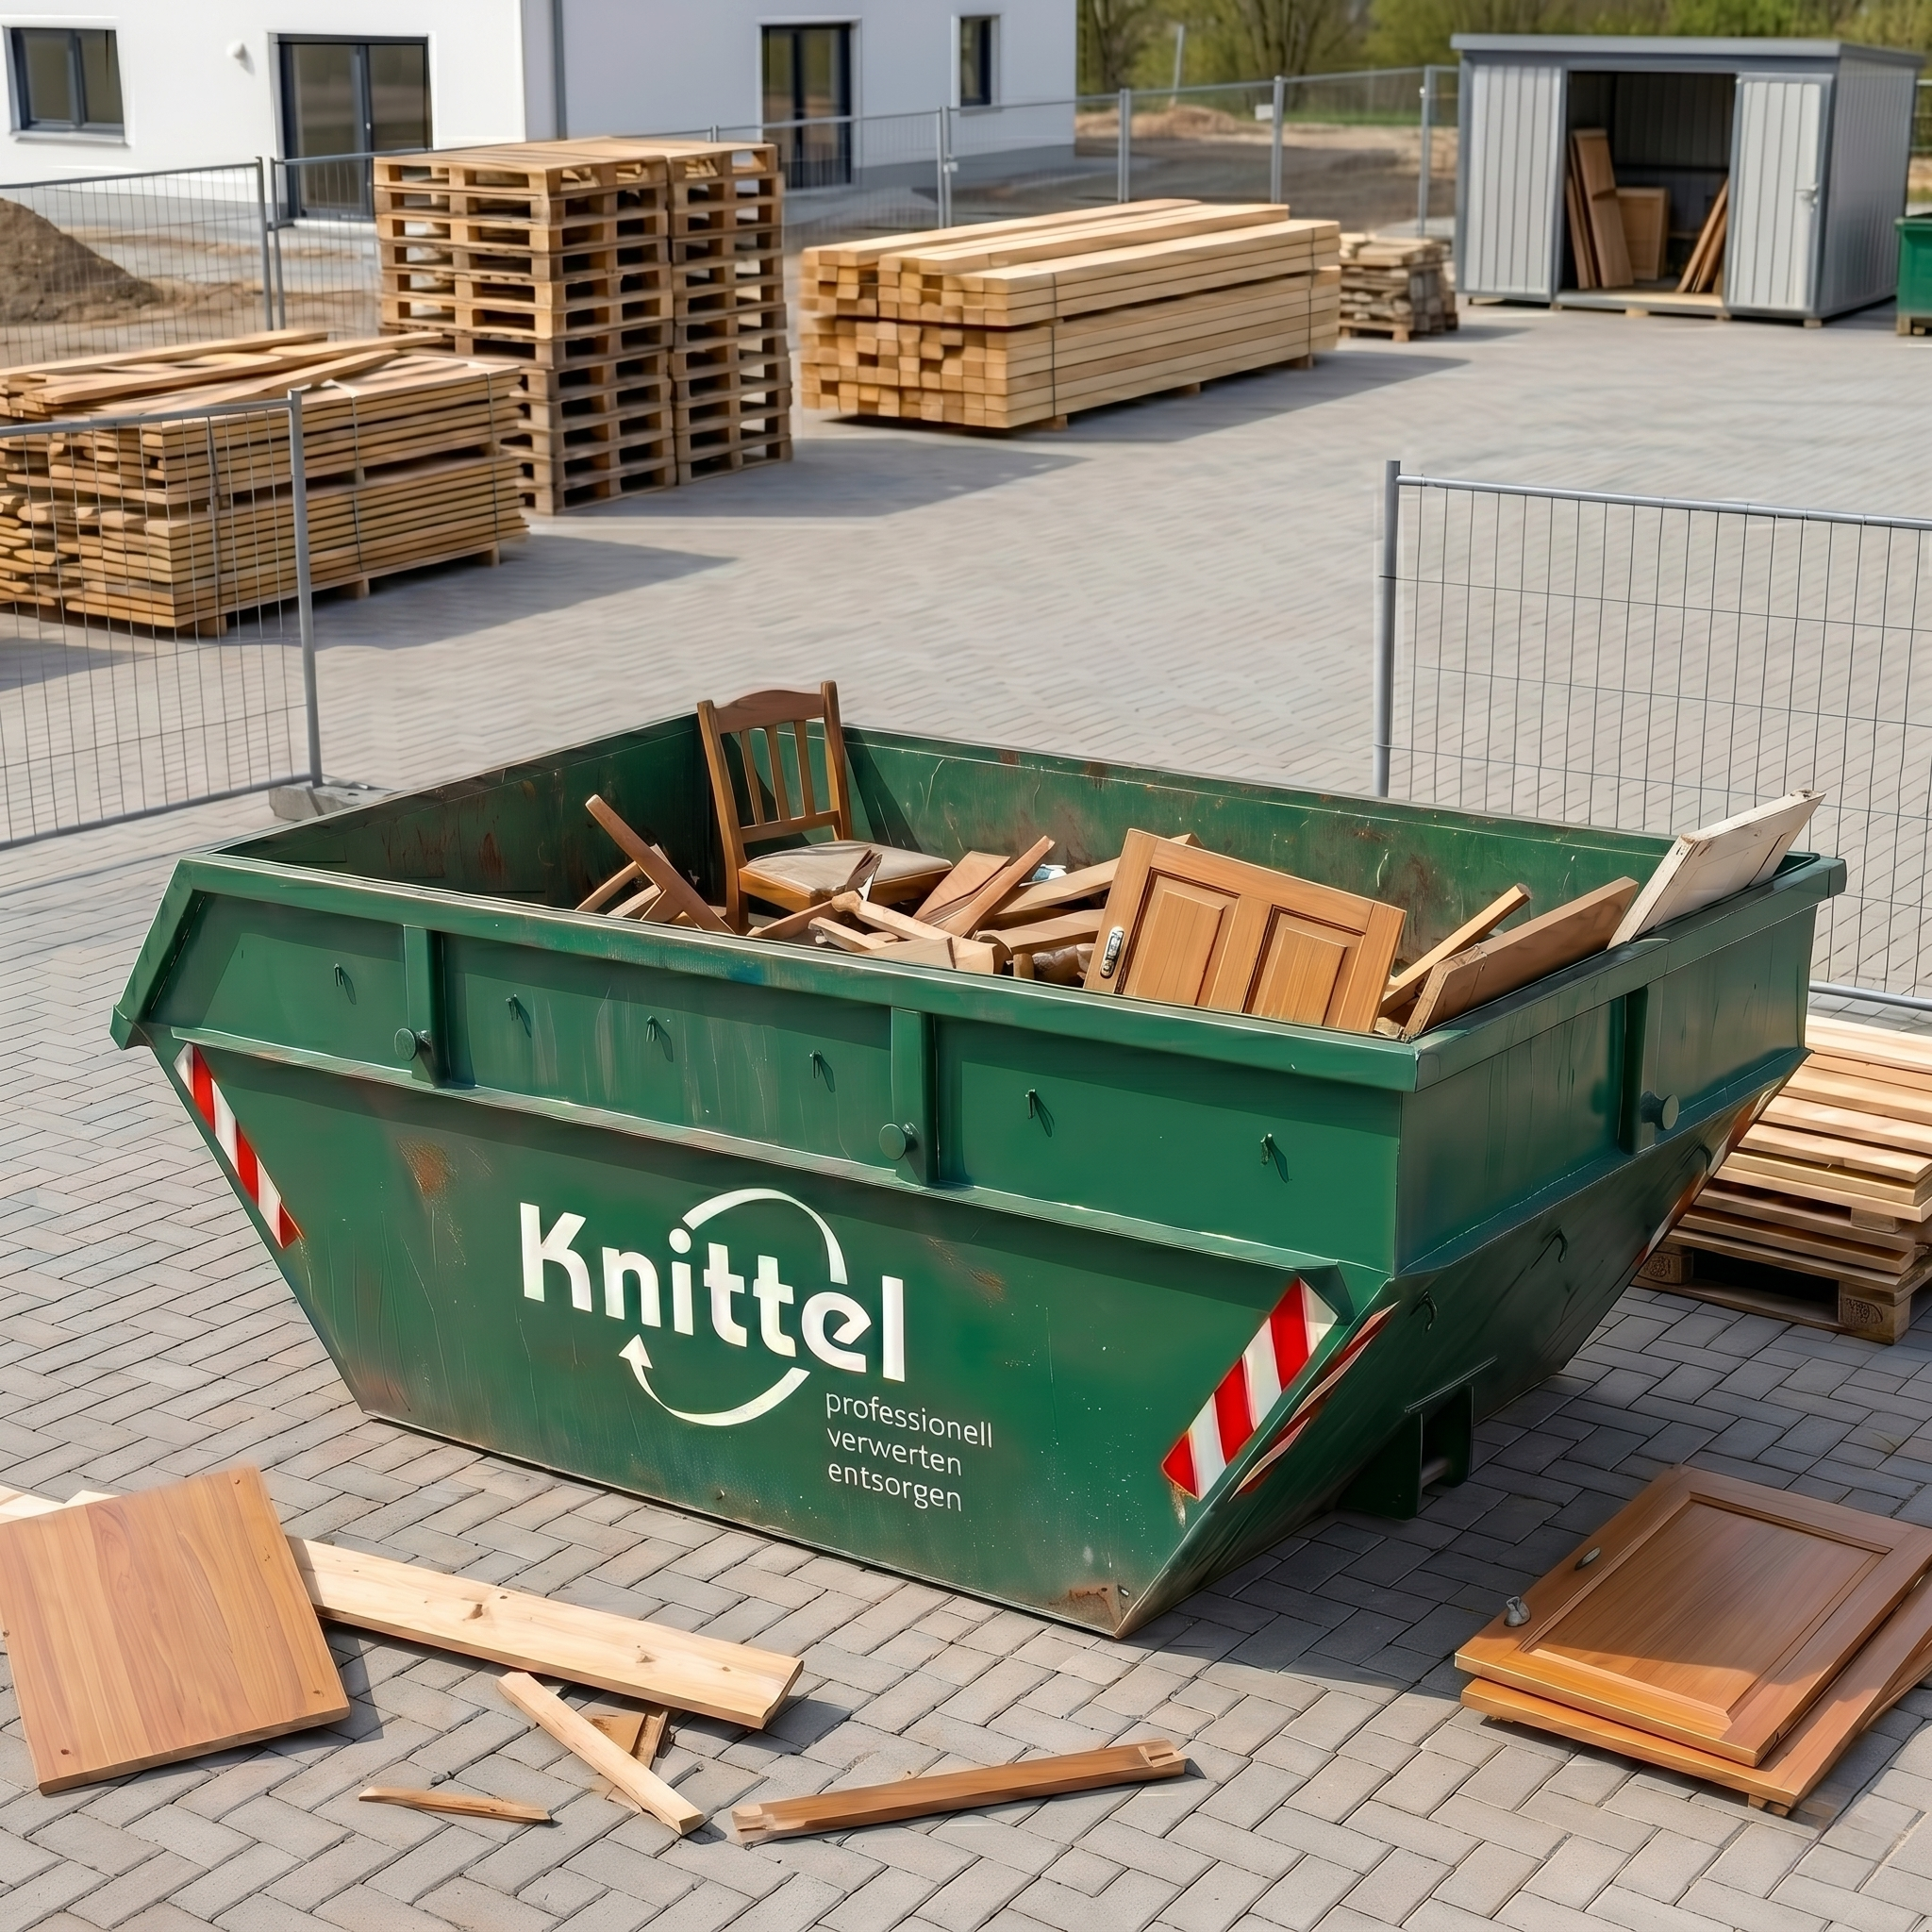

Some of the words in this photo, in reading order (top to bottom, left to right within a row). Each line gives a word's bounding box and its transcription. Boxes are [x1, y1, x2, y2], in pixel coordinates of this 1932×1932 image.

[519, 1202, 906, 1383] Knittel
[825, 1391, 993, 1448] professionell
[826, 1426, 962, 1476] verwerten
[827, 1462, 962, 1512] entsorgen
